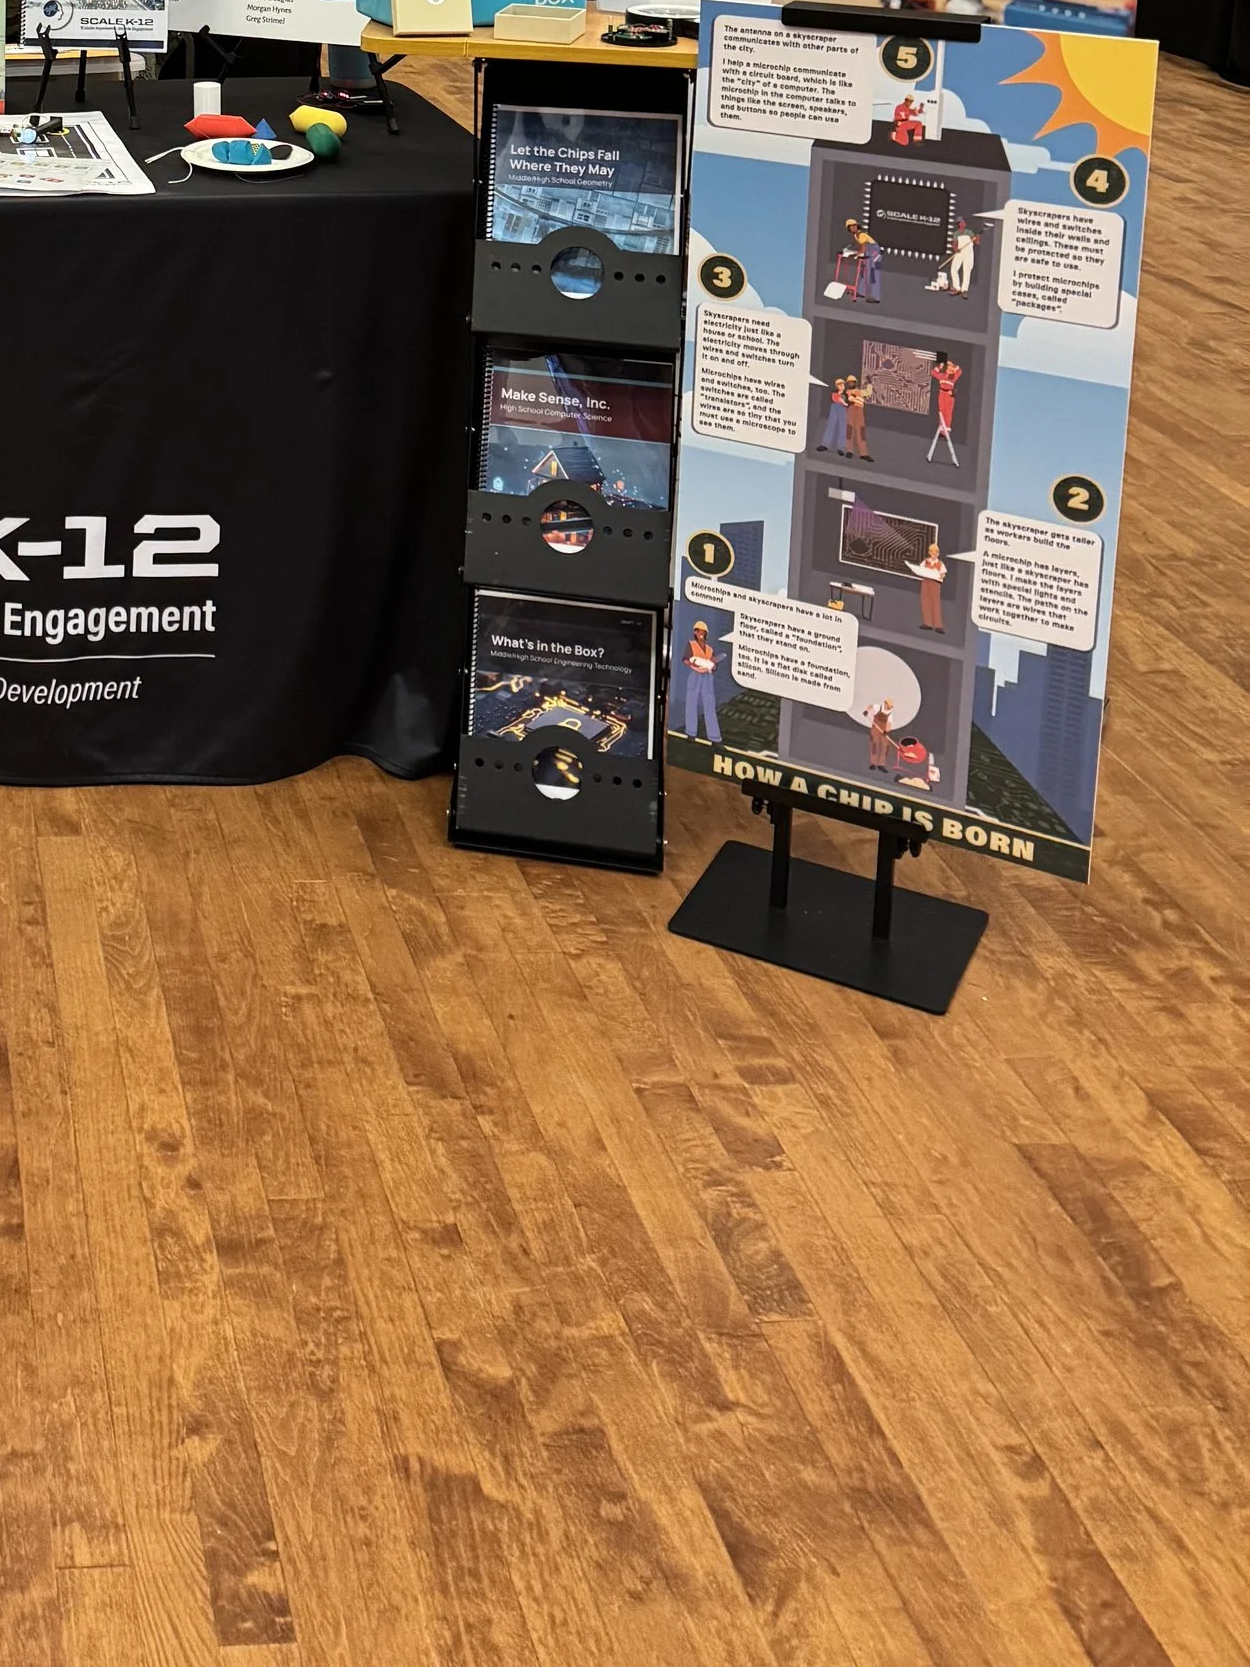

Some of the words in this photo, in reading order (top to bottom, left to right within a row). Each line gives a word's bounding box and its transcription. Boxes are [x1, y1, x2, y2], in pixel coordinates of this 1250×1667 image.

[724, 25, 738, 33] The
[739, 28, 772, 37] antenna
[792, 33, 837, 44] skyscraper
[896, 45, 919, 71] 5
[510, 144, 531, 156] Let
[533, 145, 555, 158] the
[558, 146, 595, 161] Chips
[598, 148, 620, 161] Fall
[509, 159, 552, 172] Where
[554, 162, 586, 176] They
[588, 163, 615, 178] May
[1085, 170, 1110, 193] 4
[886, 210, 918, 220] SCALE
[919, 214, 941, 223] K-12
[713, 266, 732, 288] 3
[501, 388, 536, 402] Make
[539, 390, 584, 408] Sense,
[587, 395, 611, 411] Inc.
[500, 403, 516, 413] High
[518, 405, 543, 416] School
[545, 407, 581, 420] Computer
[583, 412, 612, 423] Science
[1068, 487, 1090, 511] 2
[703, 542, 716, 564] 1
[2, 600, 217, 642] Engagement
[491, 634, 534, 651] What's
[536, 639, 547, 652] in
[550, 640, 572, 654] the
[574, 643, 605, 659] Box?
[713, 754, 783, 785] HOW
[790, 776, 809, 793] A
[817, 783, 894, 815] CHIP
[902, 807, 934, 832] IS
[942, 817, 1035, 862] BORN
